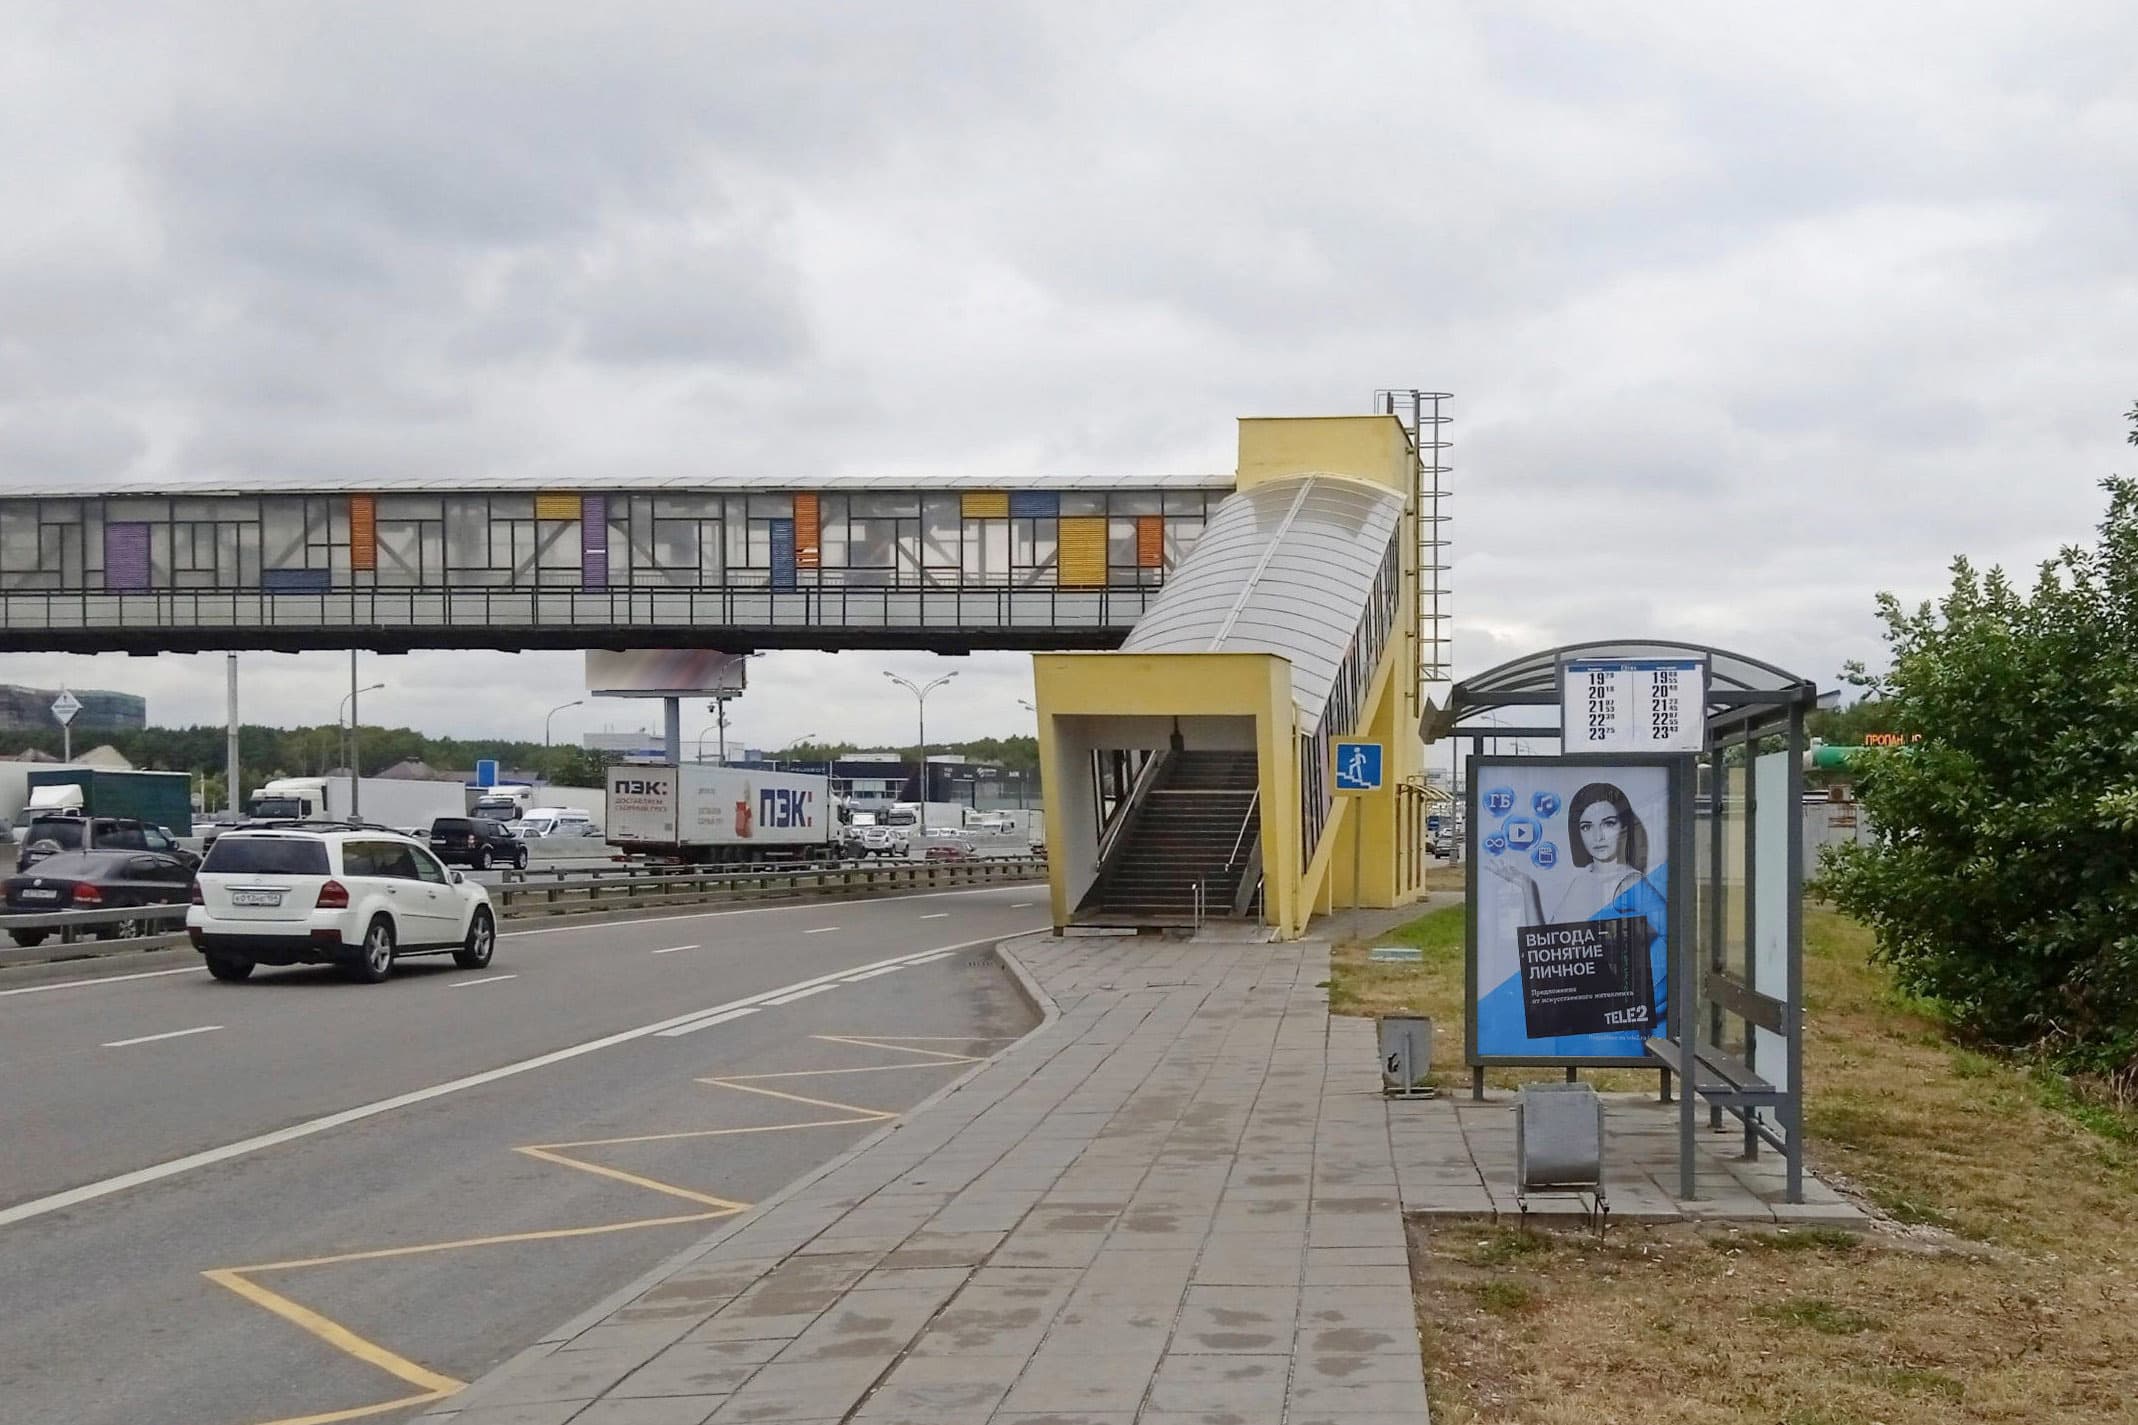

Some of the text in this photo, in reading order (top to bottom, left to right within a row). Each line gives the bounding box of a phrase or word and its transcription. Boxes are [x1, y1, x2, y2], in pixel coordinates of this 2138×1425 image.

[1589, 672, 1605, 685] 19
[1652, 671, 1668, 684] 19
[1589, 686, 1605, 699] 20
[1652, 685, 1668, 698] 20
[1589, 700, 1604, 713] 21
[1652, 699, 1667, 712] 21
[1589, 714, 1605, 726] 22
[1652, 712, 1668, 726] 22
[1589, 727, 1606, 740] 23
[1652, 726, 1669, 739] 23
[1865, 733, 1904, 746] ПРОПАН
[1488, 793, 1511, 809] ГБ
[1526, 929, 1595, 947] ВЫГОДА
[1527, 945, 1603, 963] ПОНЯТИЕ
[1529, 962, 1596, 980] ЛИЧНОЕ
[1603, 1004, 1649, 1025] TELE2
